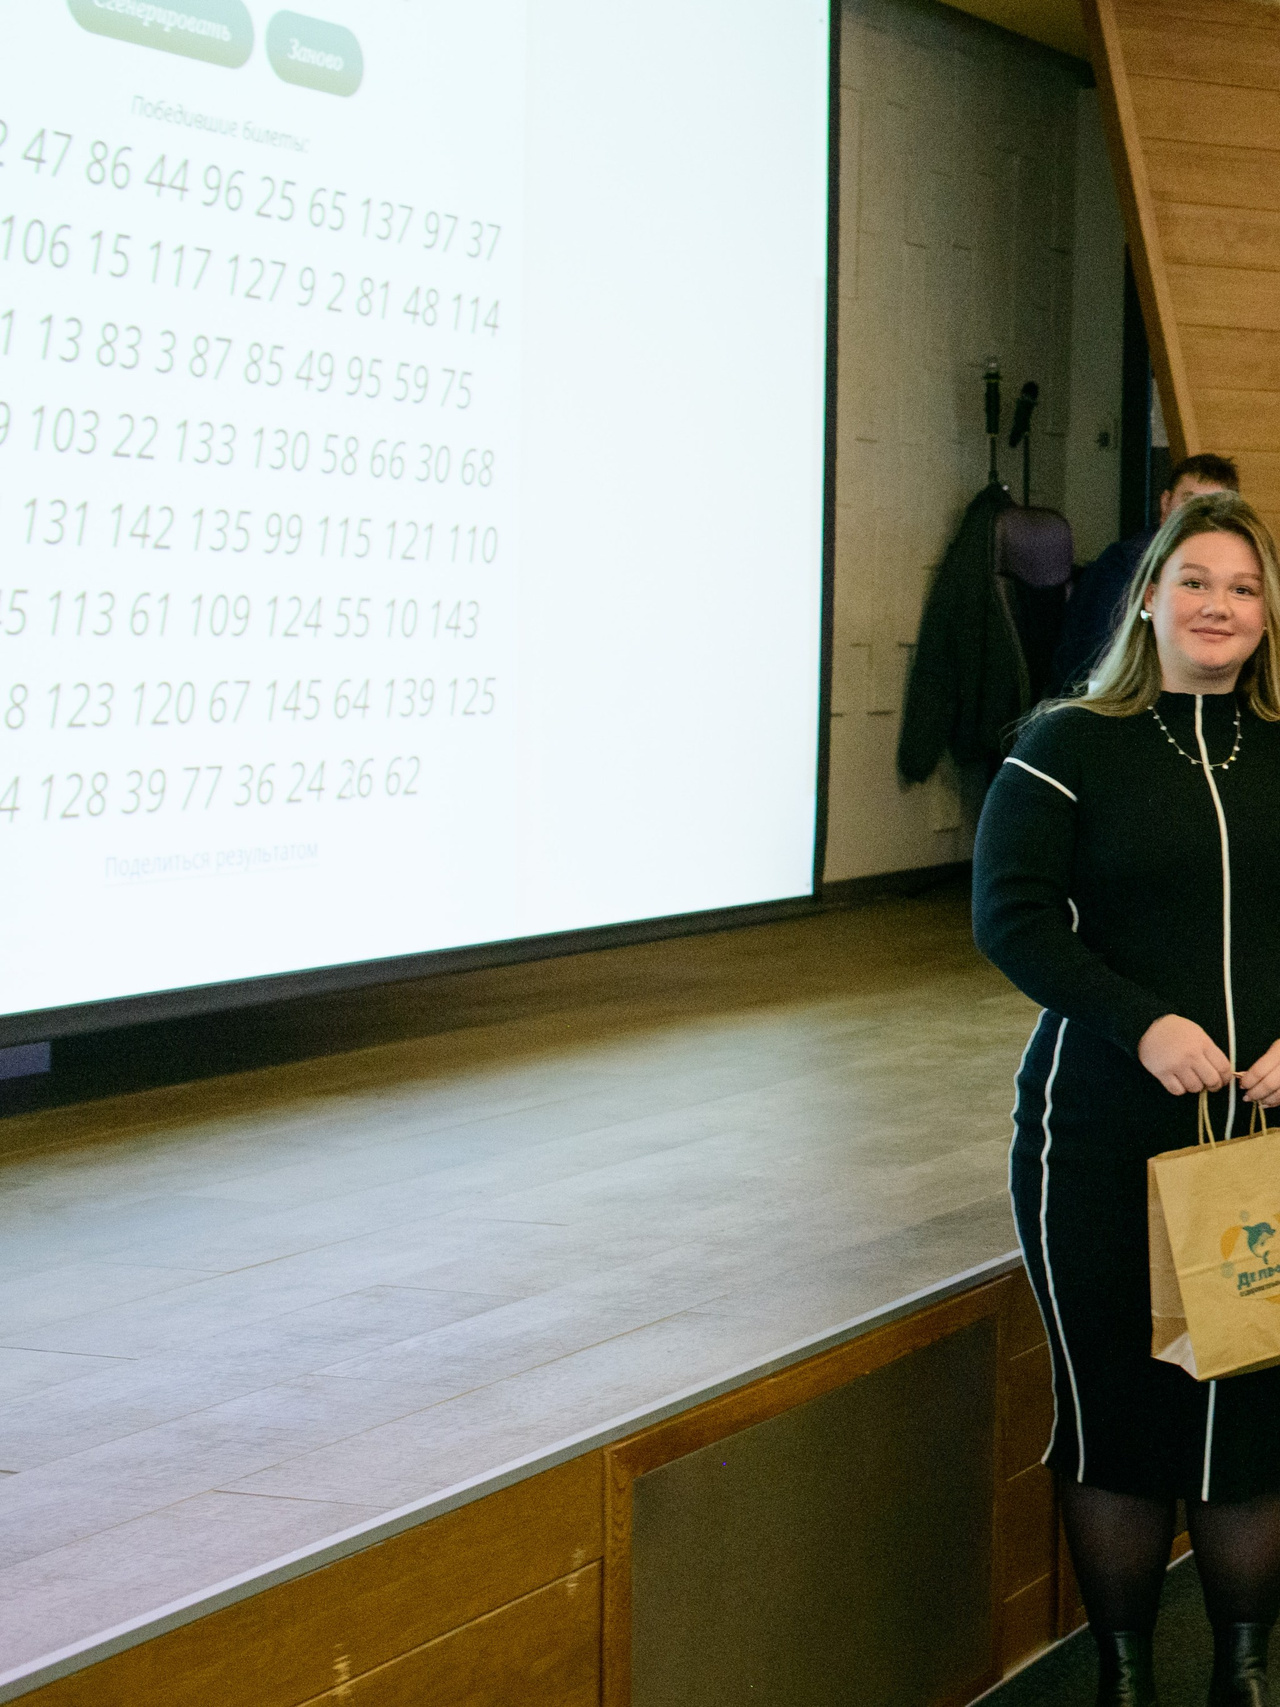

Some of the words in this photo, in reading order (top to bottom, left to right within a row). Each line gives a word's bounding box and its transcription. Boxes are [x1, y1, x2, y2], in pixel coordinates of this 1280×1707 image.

[286, 37, 345, 72] Заново
[131, 95, 238, 137] Победившие
[22, 128, 72, 176] 47
[86, 141, 132, 189] 86
[144, 155, 188, 200] 44
[202, 165, 244, 211] 96
[255, 176, 296, 221] 25
[309, 188, 346, 231] 65
[361, 198, 413, 243] 137
[424, 211, 458, 251] 97
[467, 221, 501, 260] 37
[0, 215, 71, 268] 106
[90, 231, 131, 278] 15
[150, 241, 211, 289] 117
[228, 255, 286, 301] 127
[298, 267, 315, 306] 9
[326, 272, 345, 312] 2
[356, 277, 388, 319] 81
[403, 287, 439, 326] 48
[453, 294, 499, 336] 114
[40, 314, 82, 362] 13
[96, 322, 141, 369] 83
[155, 330, 176, 373] 3
[189, 335, 232, 379] 87
[244, 342, 283, 386] 85
[295, 350, 333, 392] 49
[346, 356, 382, 398] 95
[394, 362, 428, 403] 59
[441, 368, 472, 409] 75
[32, 406, 99, 454] 103
[112, 414, 158, 460] 22
[177, 420, 236, 465] 133
[254, 428, 308, 472] 130
[321, 434, 358, 475] 58
[371, 439, 405, 480] 66
[416, 444, 450, 483] 30
[461, 449, 494, 487] 68
[24, 498, 88, 546] 131
[111, 503, 173, 550] 142
[193, 508, 251, 553] 135
[264, 513, 302, 555] 99
[319, 517, 371, 558] 115
[388, 521, 433, 560] 121
[451, 525, 497, 564] 110
[0, 589, 28, 636] 5
[49, 591, 114, 636] 113
[130, 592, 169, 636] 61
[192, 594, 249, 637] 109
[268, 596, 321, 637] 124
[334, 597, 370, 637] 55
[386, 599, 417, 637] 10
[432, 601, 479, 638] 143
[49, 682, 114, 728] 123
[134, 682, 195, 725] 120
[209, 681, 250, 723] 67
[267, 680, 321, 721] 145
[334, 679, 369, 719] 64
[386, 678, 434, 717] 139
[450, 677, 495, 716] 125
[41, 772, 108, 820] 128
[121, 769, 165, 815] 39
[182, 766, 222, 810] 77
[234, 763, 275, 806] 36
[285, 761, 325, 803] 24
[336, 758, 373, 800] 26
[385, 756, 420, 796] 62
[104, 850, 211, 879] Поделиться
[215, 840, 319, 872] результатом
